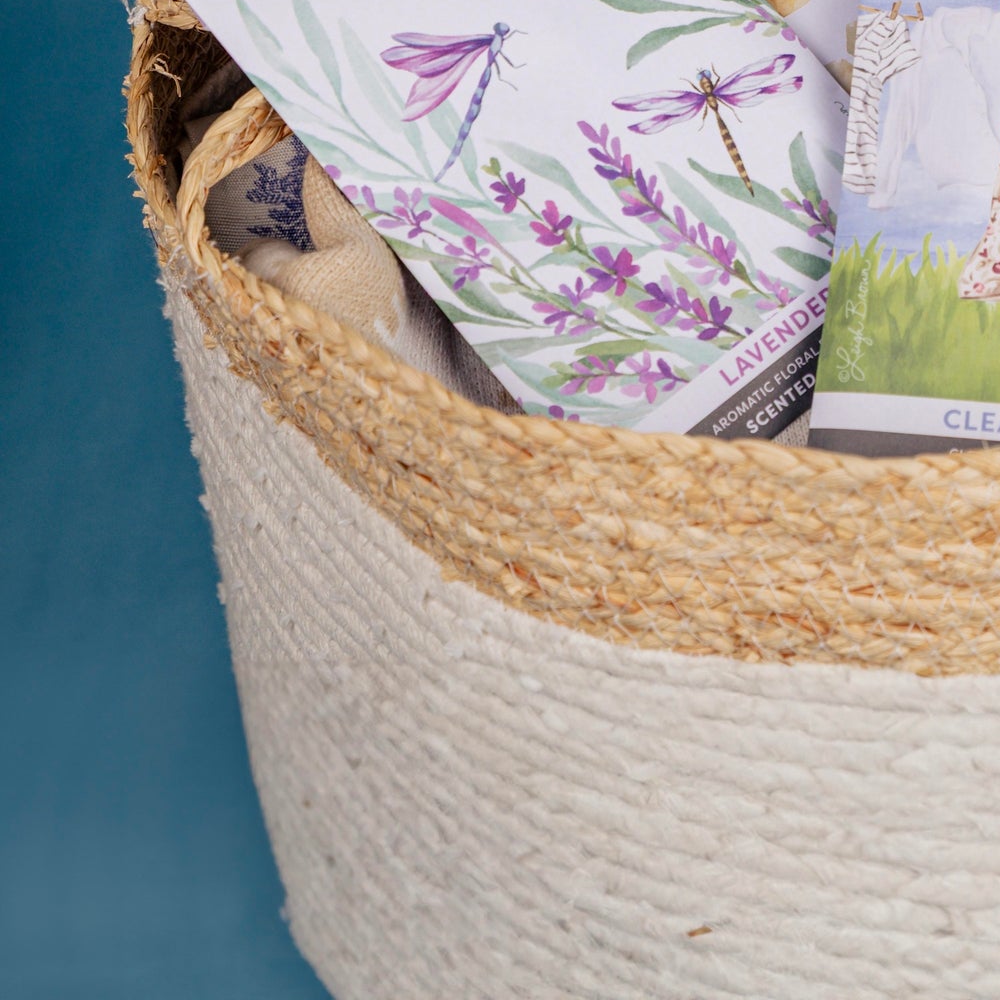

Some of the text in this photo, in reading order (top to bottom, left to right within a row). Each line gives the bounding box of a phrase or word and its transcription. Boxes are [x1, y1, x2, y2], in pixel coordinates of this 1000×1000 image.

[844, 259, 872, 320] Brown
[711, 346, 820, 436] AROMATIC FLORAL
[745, 372, 817, 434] SCENTED
